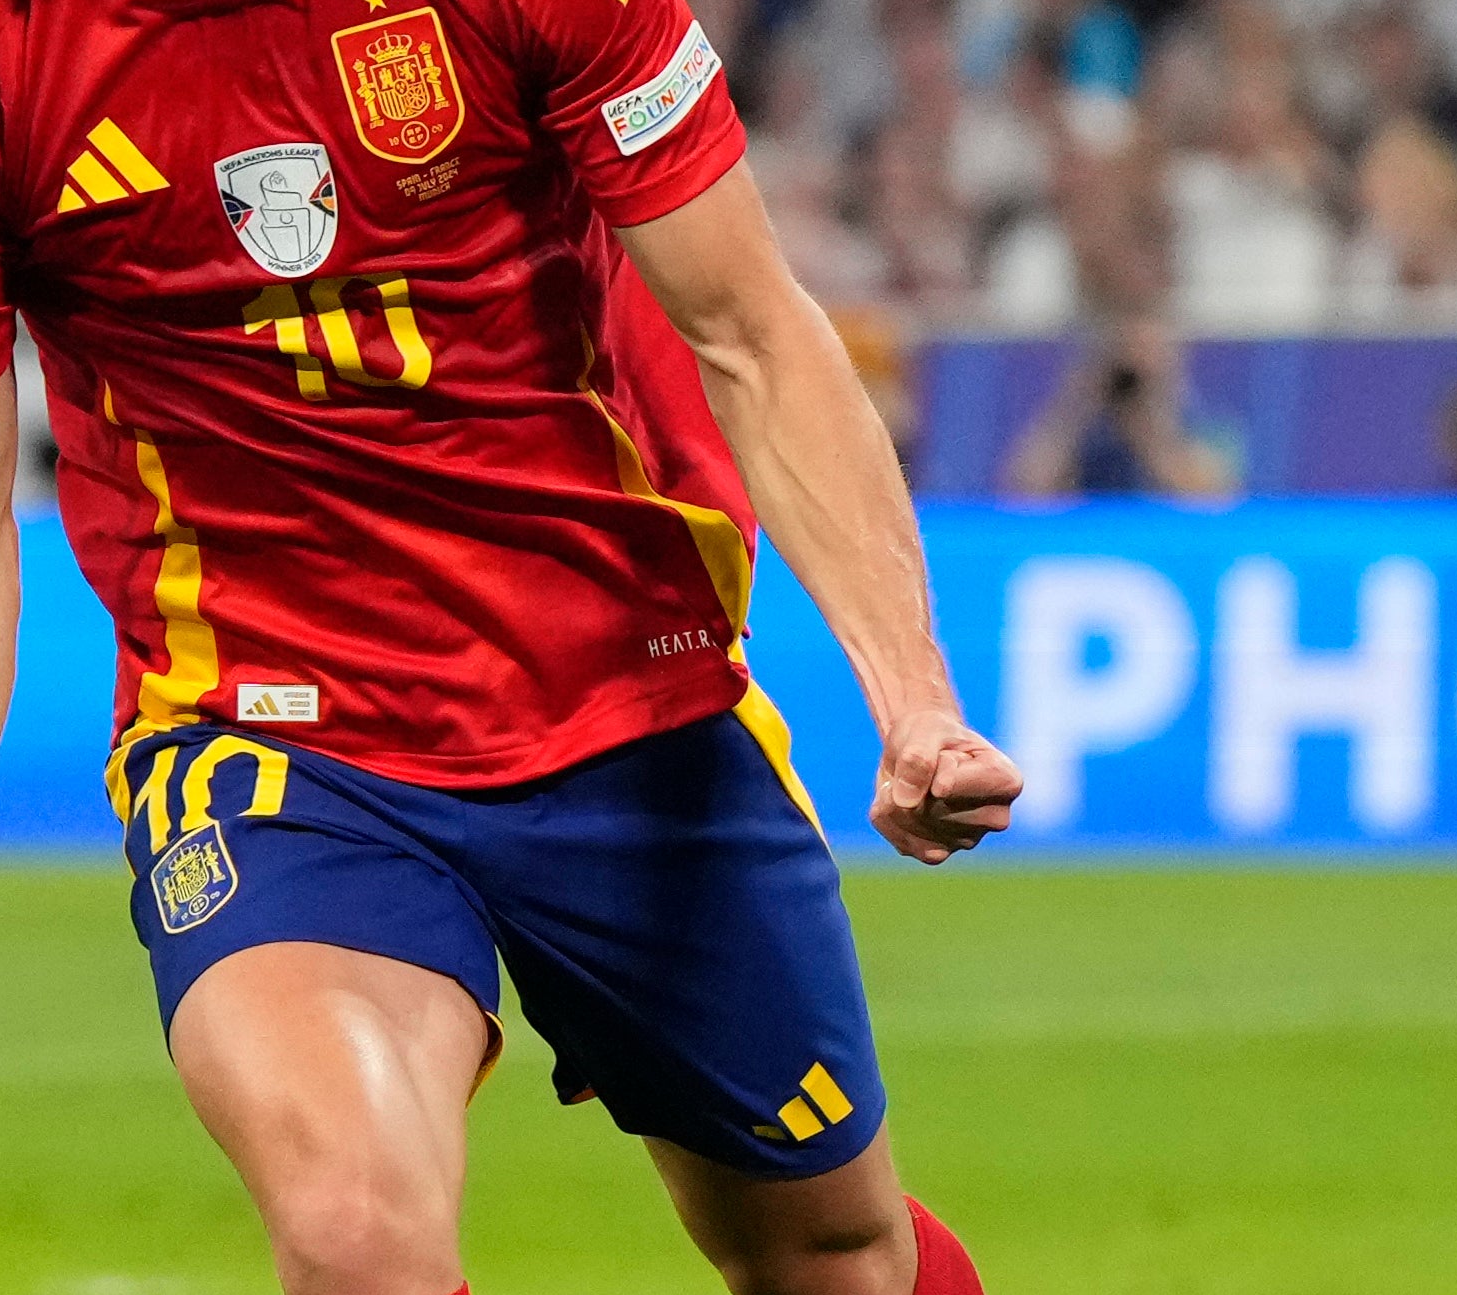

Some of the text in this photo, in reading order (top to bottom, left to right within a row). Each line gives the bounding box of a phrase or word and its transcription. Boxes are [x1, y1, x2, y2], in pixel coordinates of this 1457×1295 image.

[607, 95, 643, 118] UEFA
[613, 37, 709, 137] FOUNDATION
[219, 148, 321, 173] UEFA NATIONS LEAGUE
[266, 258, 303, 272] WINNER
[242, 270, 433, 402] 10
[134, 734, 290, 856] 10
